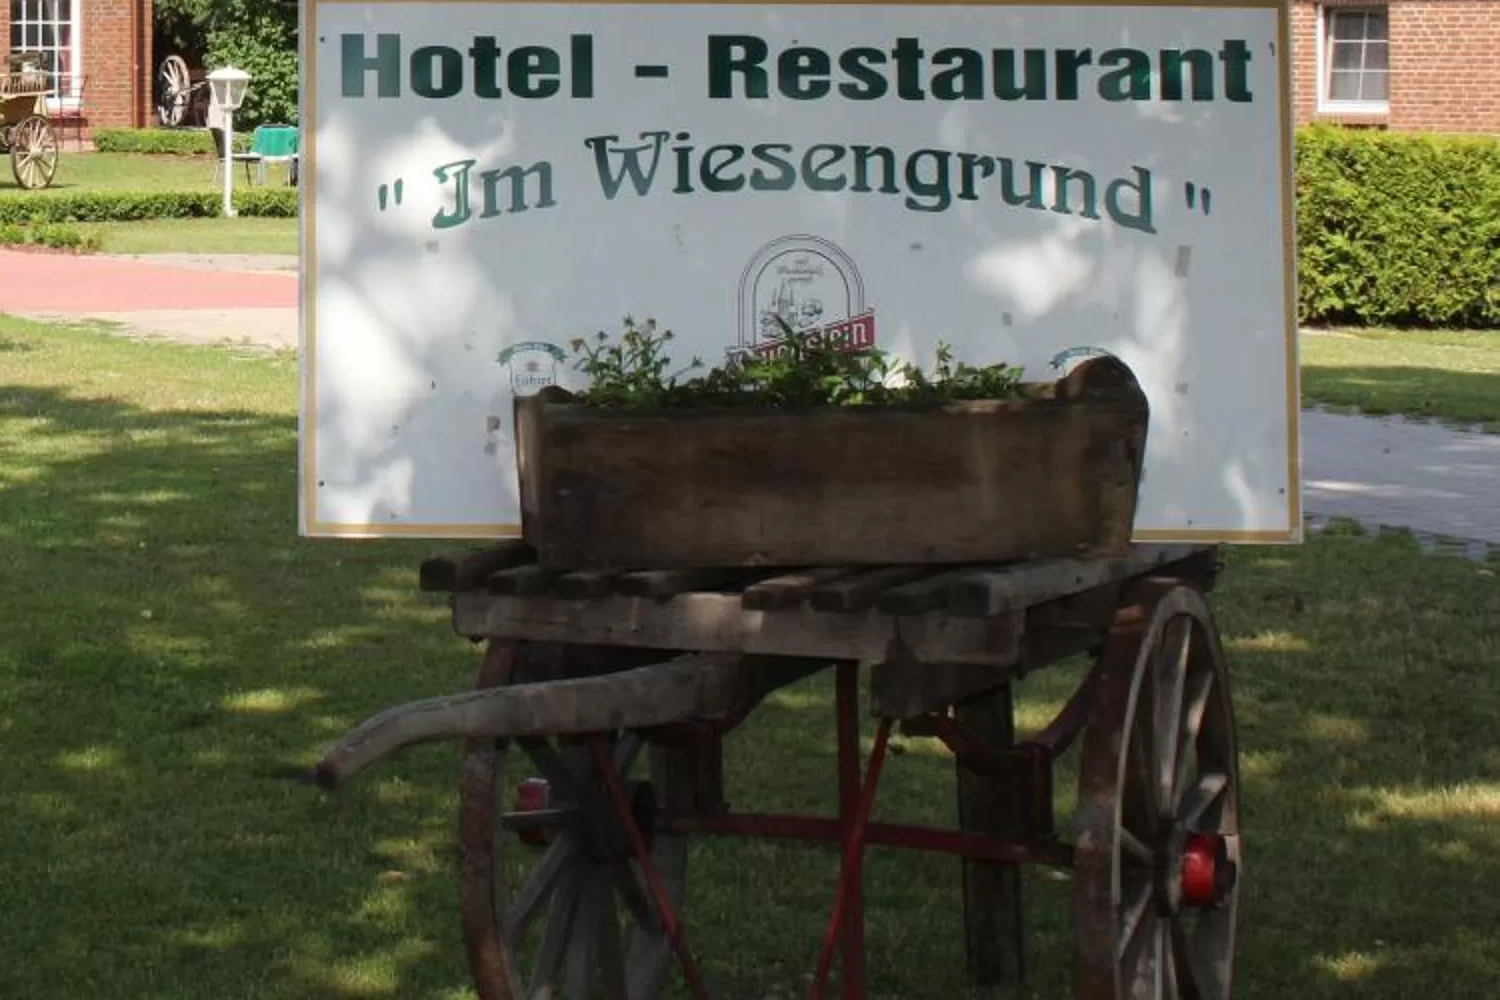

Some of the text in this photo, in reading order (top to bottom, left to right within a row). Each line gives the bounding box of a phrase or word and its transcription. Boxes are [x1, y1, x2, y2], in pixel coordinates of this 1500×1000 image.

[340, 33, 594, 99] Hotel
[707, 35, 1253, 102] Restaurant
[583, 130, 1157, 234] Wiesengrund
